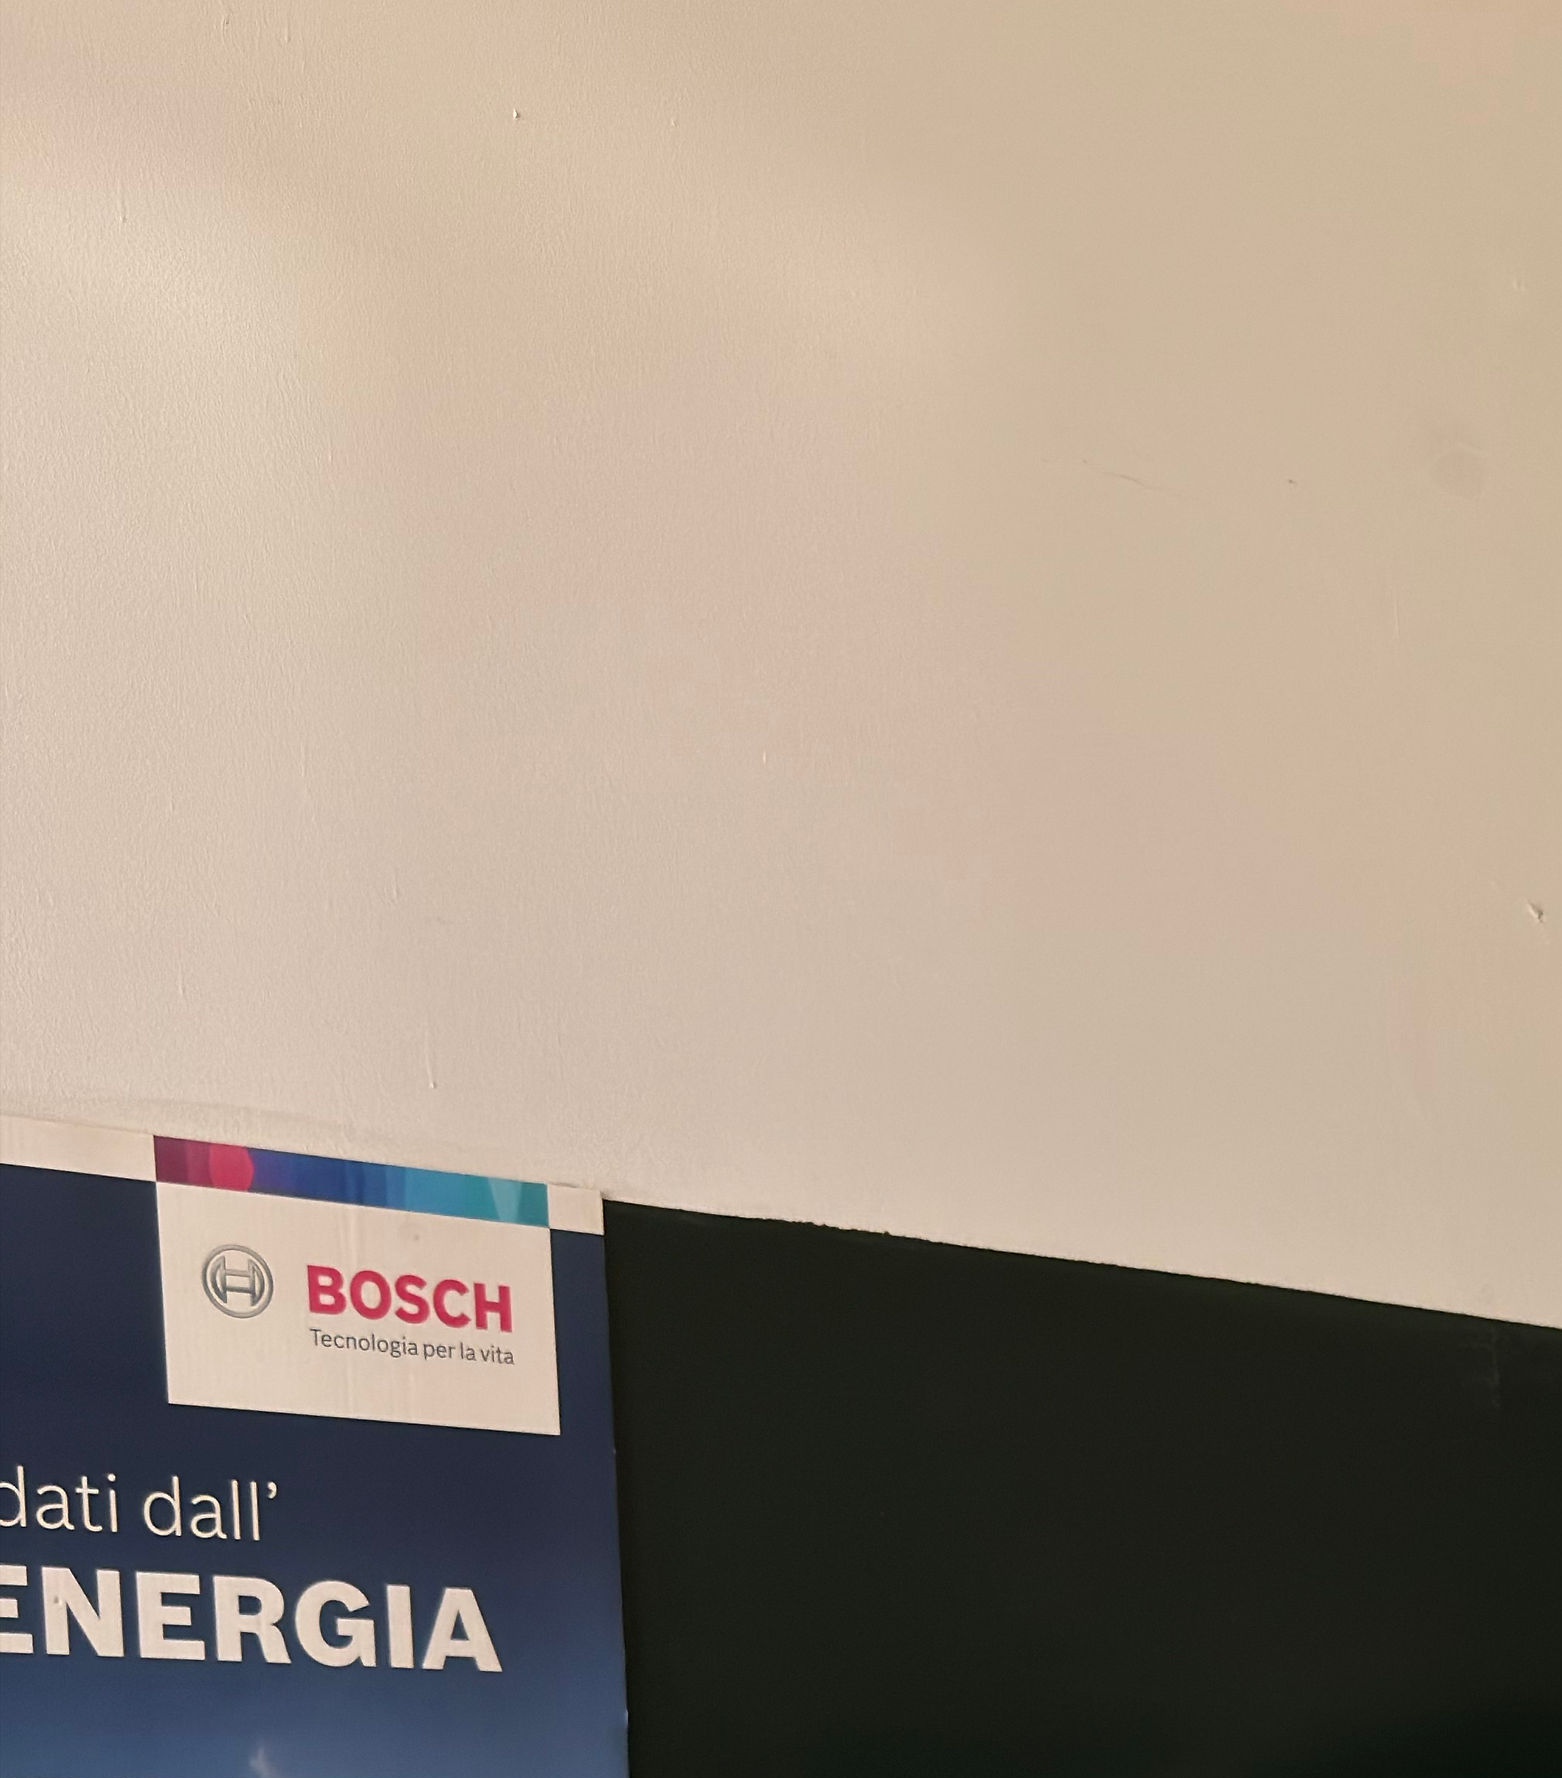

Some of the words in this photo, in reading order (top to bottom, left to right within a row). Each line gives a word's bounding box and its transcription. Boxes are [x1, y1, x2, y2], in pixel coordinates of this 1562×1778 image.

[307, 1264, 513, 1333] BOSCH
[309, 1328, 419, 1358] Tecnologia
[423, 1342, 457, 1361] per
[459, 1342, 477, 1361] la
[480, 1345, 515, 1365] vita
